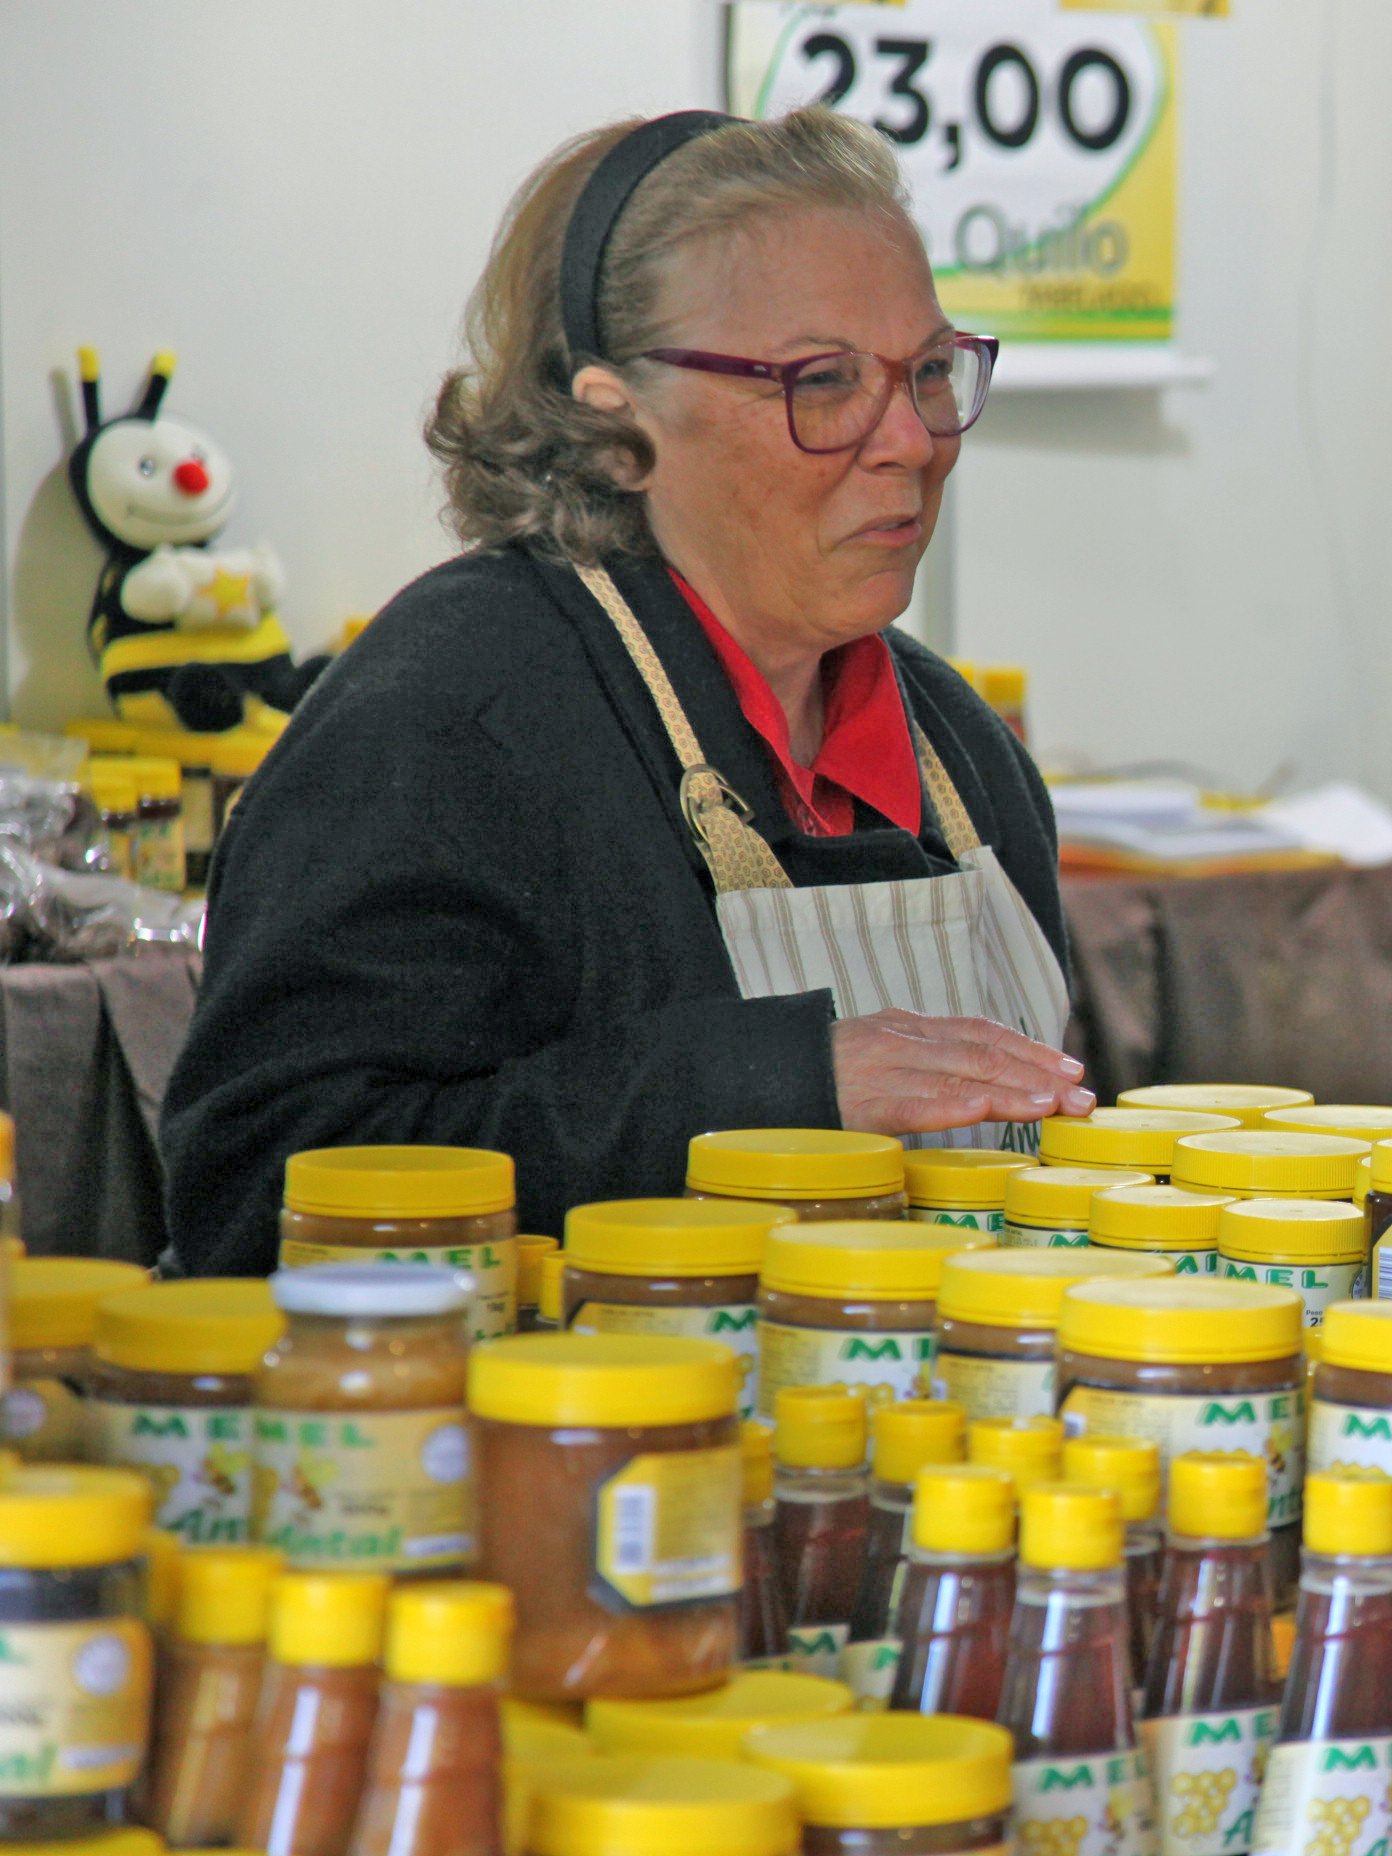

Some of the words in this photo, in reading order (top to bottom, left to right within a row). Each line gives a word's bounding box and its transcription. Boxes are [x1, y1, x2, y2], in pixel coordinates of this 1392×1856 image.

[802, 33, 1130, 171] 23,00
[936, 1213, 1004, 1231] ME
[1225, 1262, 1328, 1289] MEL
[132, 1413, 240, 1440] ME
[1188, 1711, 1275, 1746] ME
